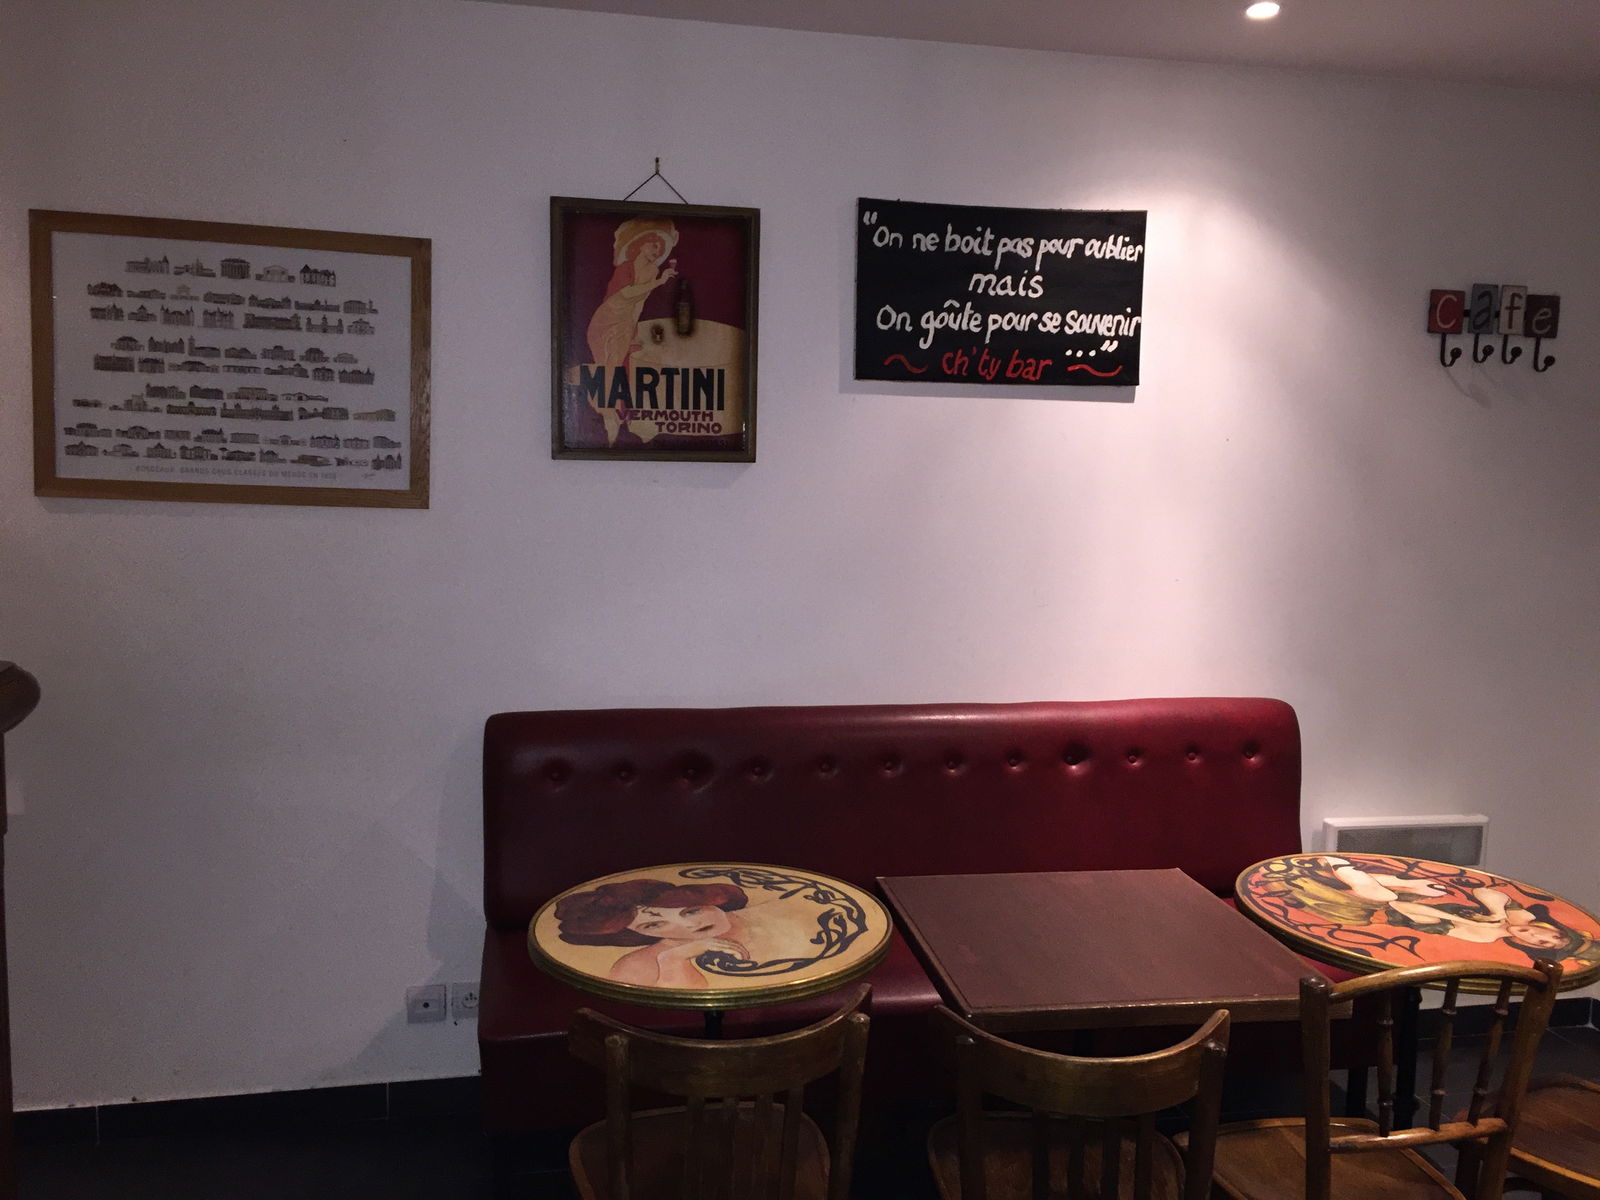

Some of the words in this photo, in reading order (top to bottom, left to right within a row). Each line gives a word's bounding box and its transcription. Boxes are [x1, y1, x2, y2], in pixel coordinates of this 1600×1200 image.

[912, 231, 940, 252] ne
[944, 223, 994, 256] boit
[994, 237, 1034, 270] pas
[1035, 237, 1084, 270] pour
[1084, 234, 1143, 262] oublier
[968, 270, 1044, 298] mais
[876, 304, 913, 332] On
[919, 299, 983, 350] goûte
[984, 312, 1037, 344] pour
[1038, 313, 1062, 334] se
[1006, 350, 1052, 381] bar
[580, 366, 725, 410] MARTINI
[616, 410, 714, 421] VERMOUTH
[655, 422, 722, 434] TORINO
